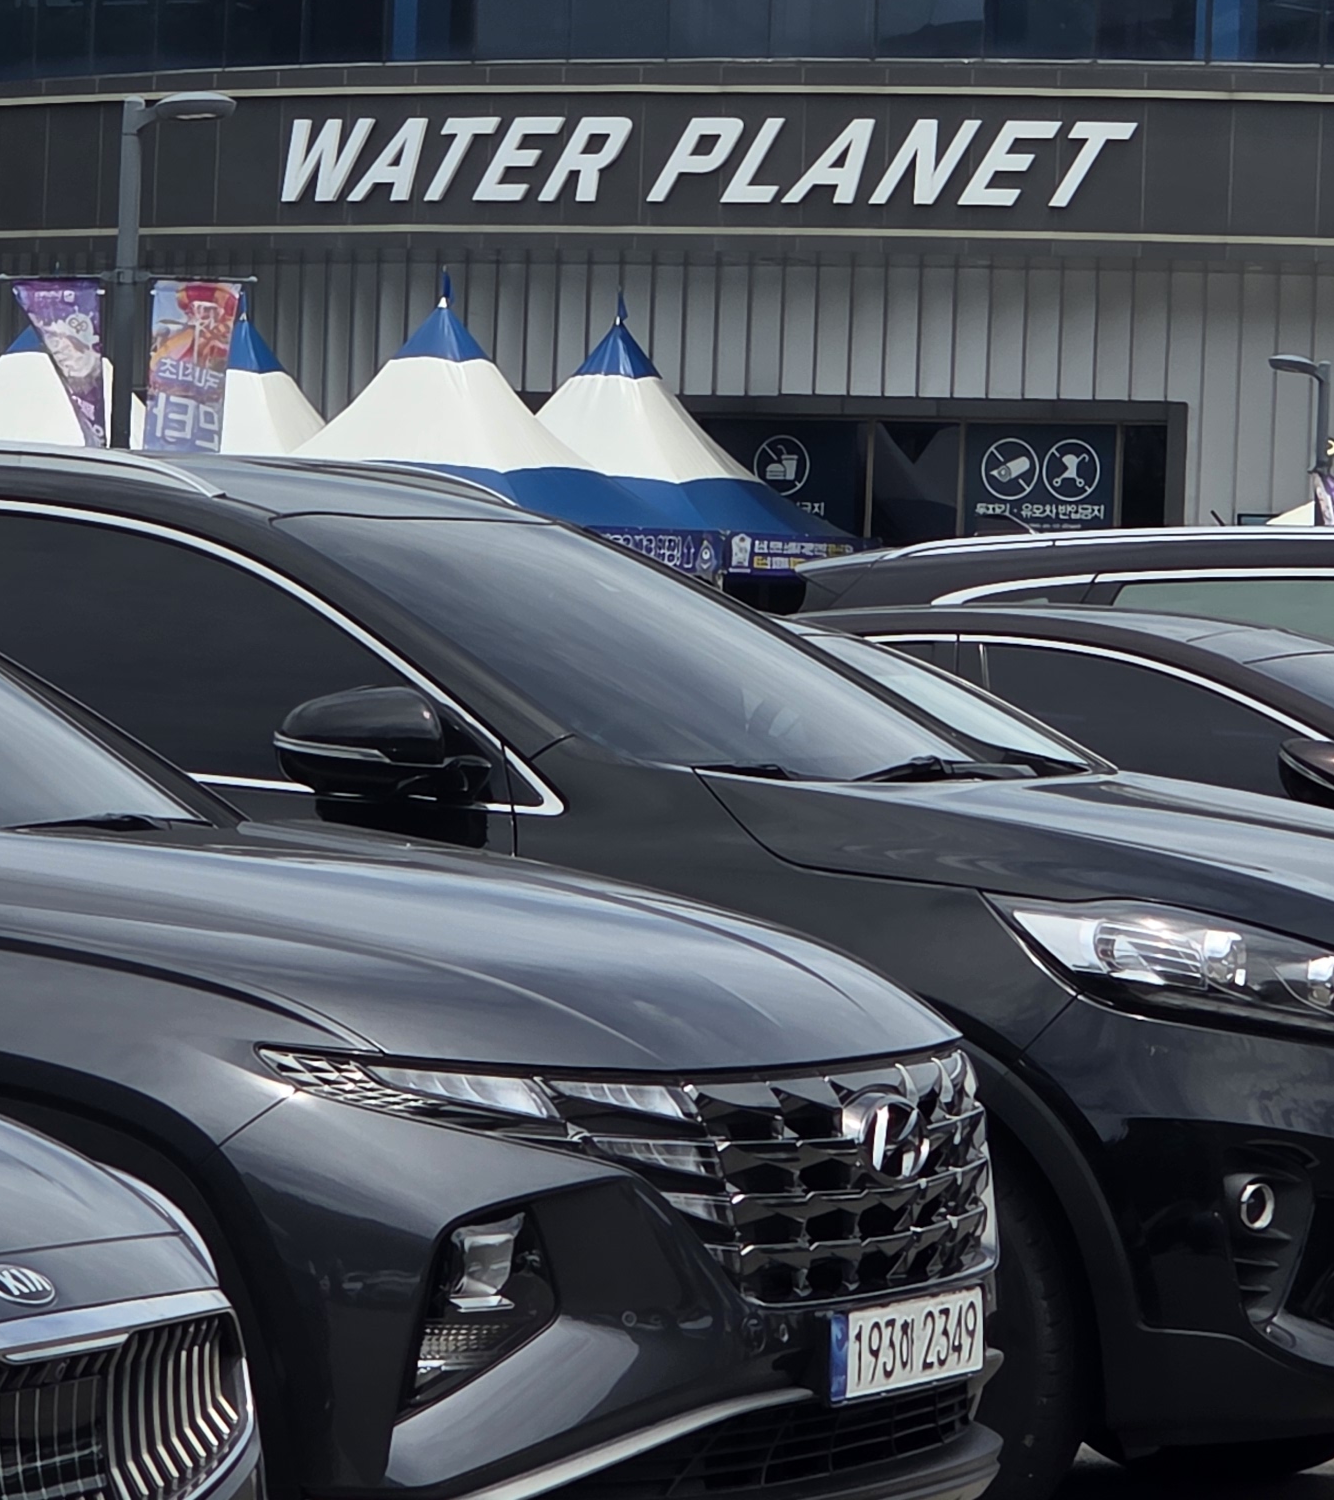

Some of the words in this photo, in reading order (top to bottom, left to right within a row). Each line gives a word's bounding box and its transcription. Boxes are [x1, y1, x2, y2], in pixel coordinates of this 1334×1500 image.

[280, 116, 633, 203] WATER
[646, 116, 1140, 208] PLANET
[1020, 502, 1057, 519] 유모차
[1058, 503, 1105, 520] 반입금지
[921, 1300, 978, 1372] 2349
